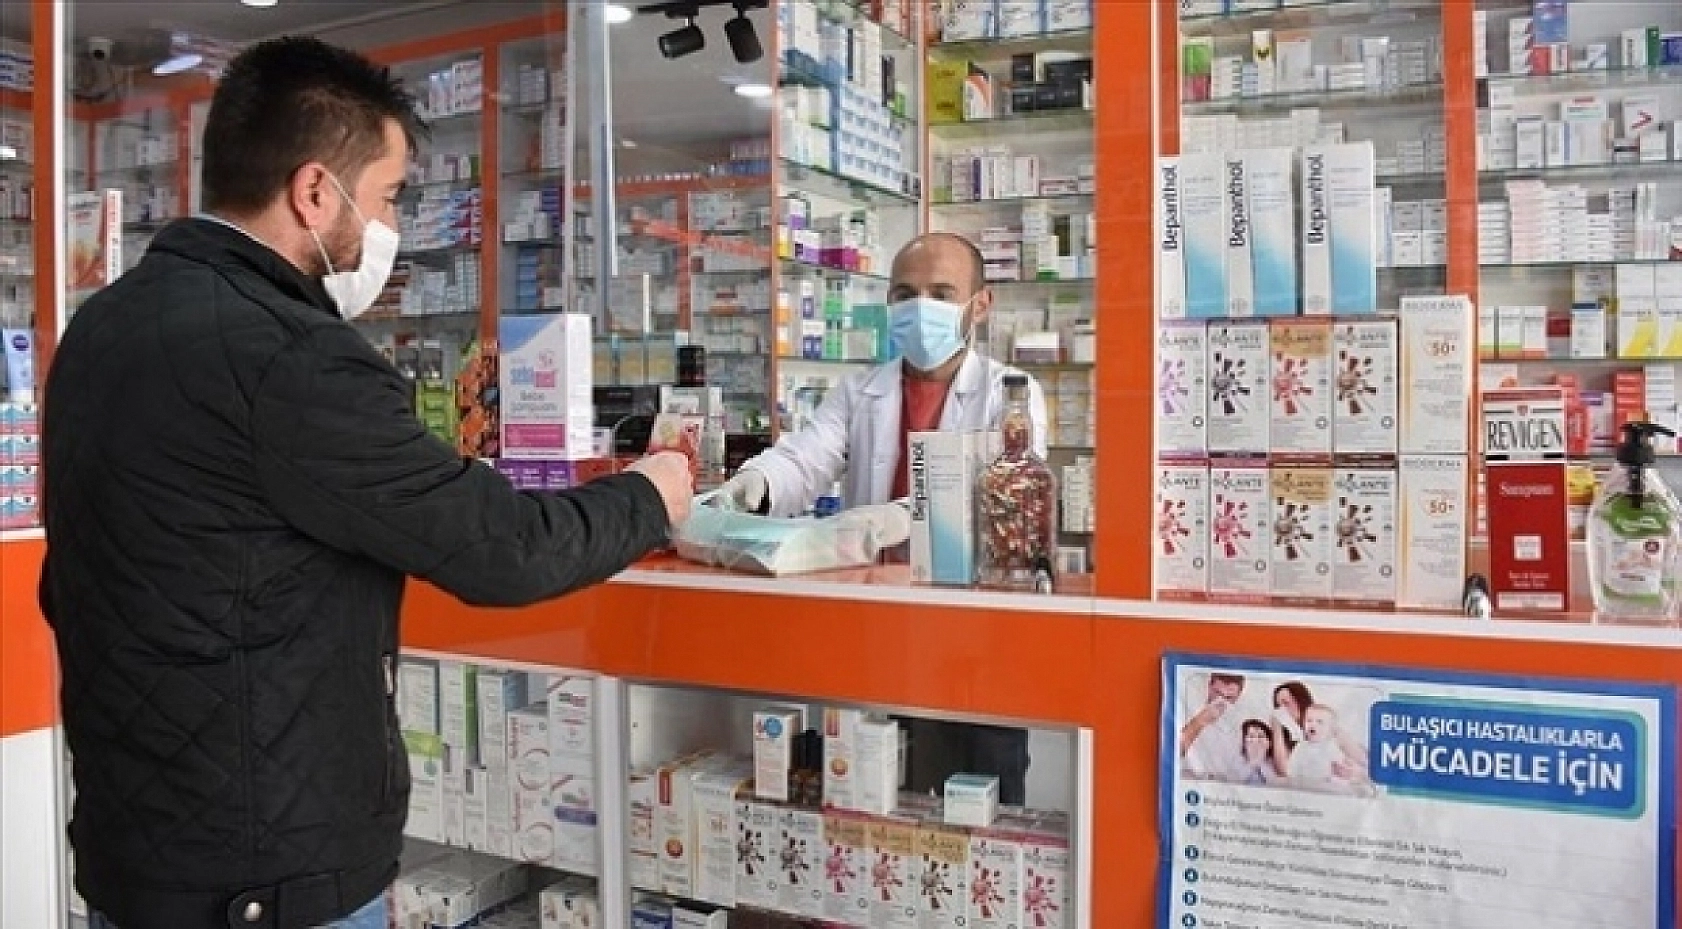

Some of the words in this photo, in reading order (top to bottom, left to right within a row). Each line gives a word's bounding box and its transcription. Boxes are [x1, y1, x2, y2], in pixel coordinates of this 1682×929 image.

[1162, 164, 1181, 249] Bepanthol
[1227, 159, 1248, 247] Bepanthol
[1307, 153, 1328, 244] Bepanthol
[1487, 419, 1564, 451] REVIGEN
[912, 440, 927, 521] Bepanthol
[1380, 713, 1464, 742] BULAŞICI
[1466, 720, 1624, 752] HASTALIKLARLA
[1380, 737, 1551, 784] MÜCADELE
[1557, 749, 1624, 796] İÇİN
